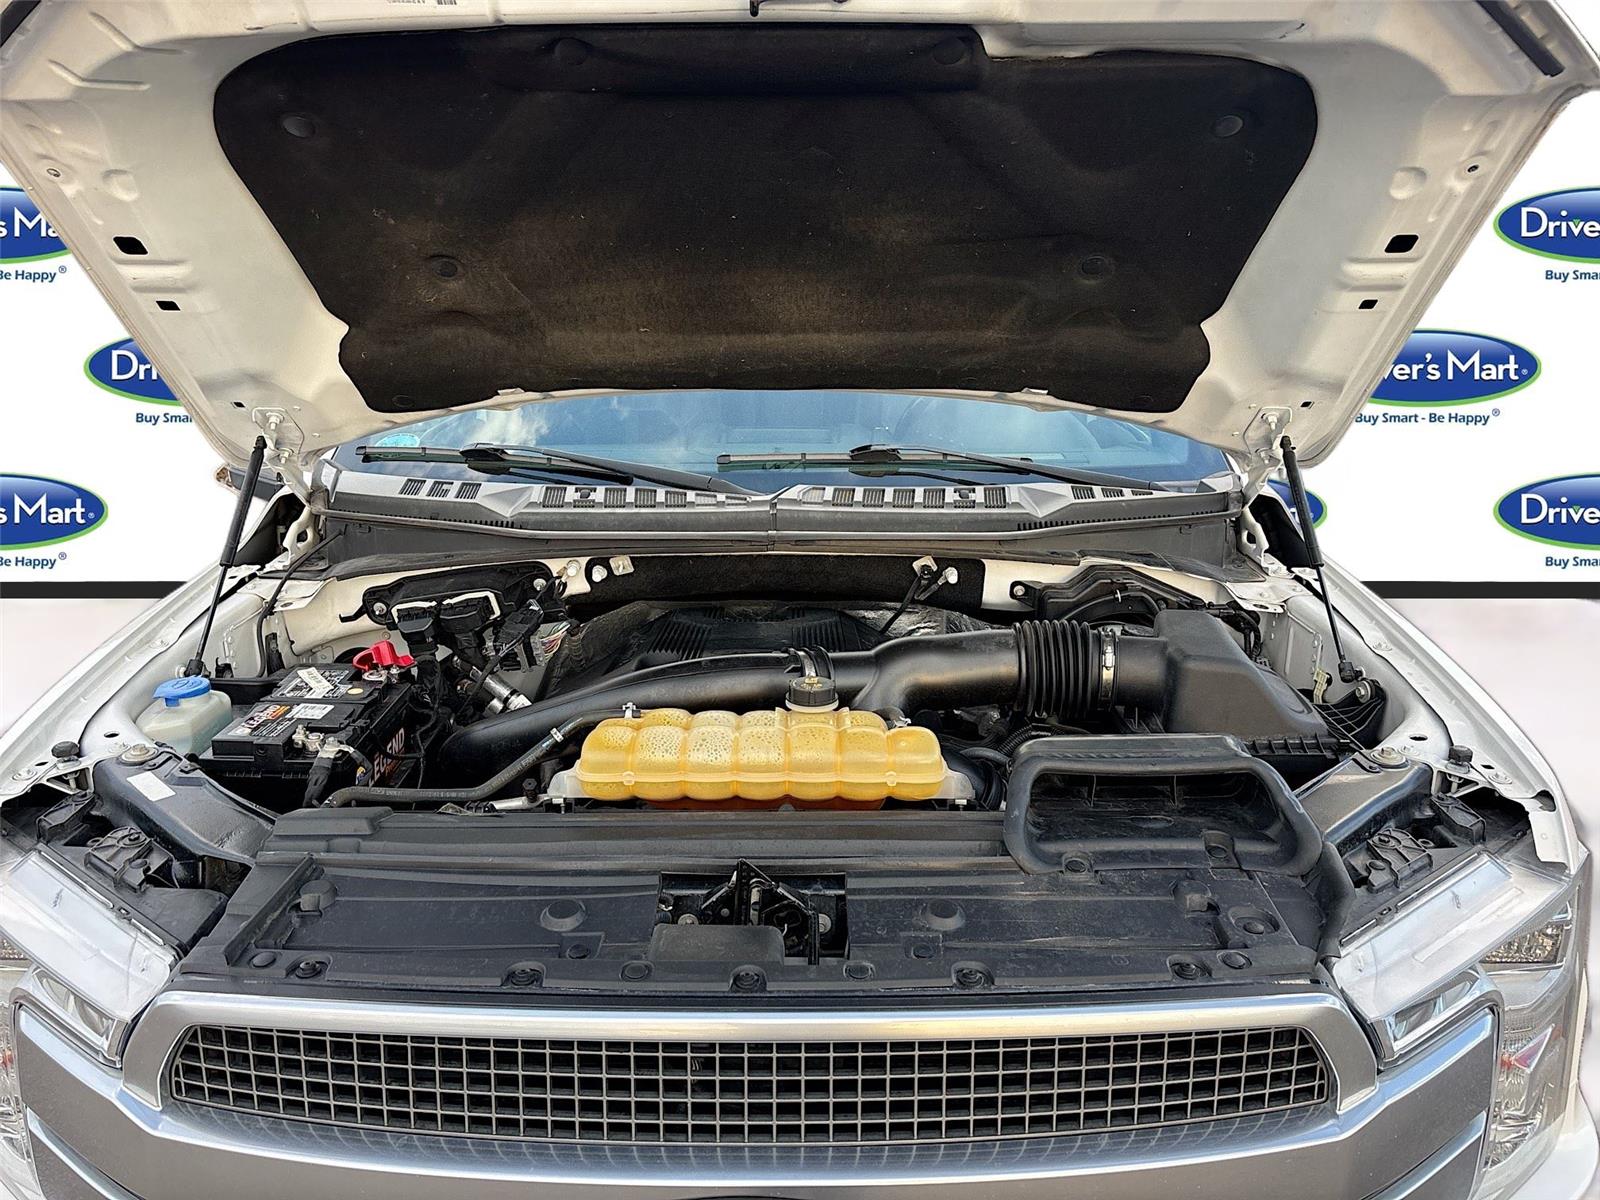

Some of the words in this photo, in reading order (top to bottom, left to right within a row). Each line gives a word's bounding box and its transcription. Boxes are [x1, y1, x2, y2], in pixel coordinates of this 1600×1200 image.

[14, 207, 59, 237] Ma
[1521, 207, 1600, 237] Drive
[15, 270, 56, 283] Happy
[1545, 270, 1570, 283] Buy
[1572, 270, 1600, 280] Sma
[1383, 353, 1441, 380] ver's
[1447, 349, 1519, 380] Mart
[135, 412, 160, 426] Buy
[162, 412, 192, 423] Smar
[1355, 413, 1379, 426] Buy
[1382, 413, 1419, 423] Smart
[1429, 413, 1445, 423] Be
[1449, 413, 1490, 426] Happy
[14, 493, 86, 524] Mart
[1521, 493, 1600, 524] Drive
[15, 556, 56, 569] Happy
[1545, 556, 1570, 569] Buy
[1572, 556, 1600, 567] Sma
